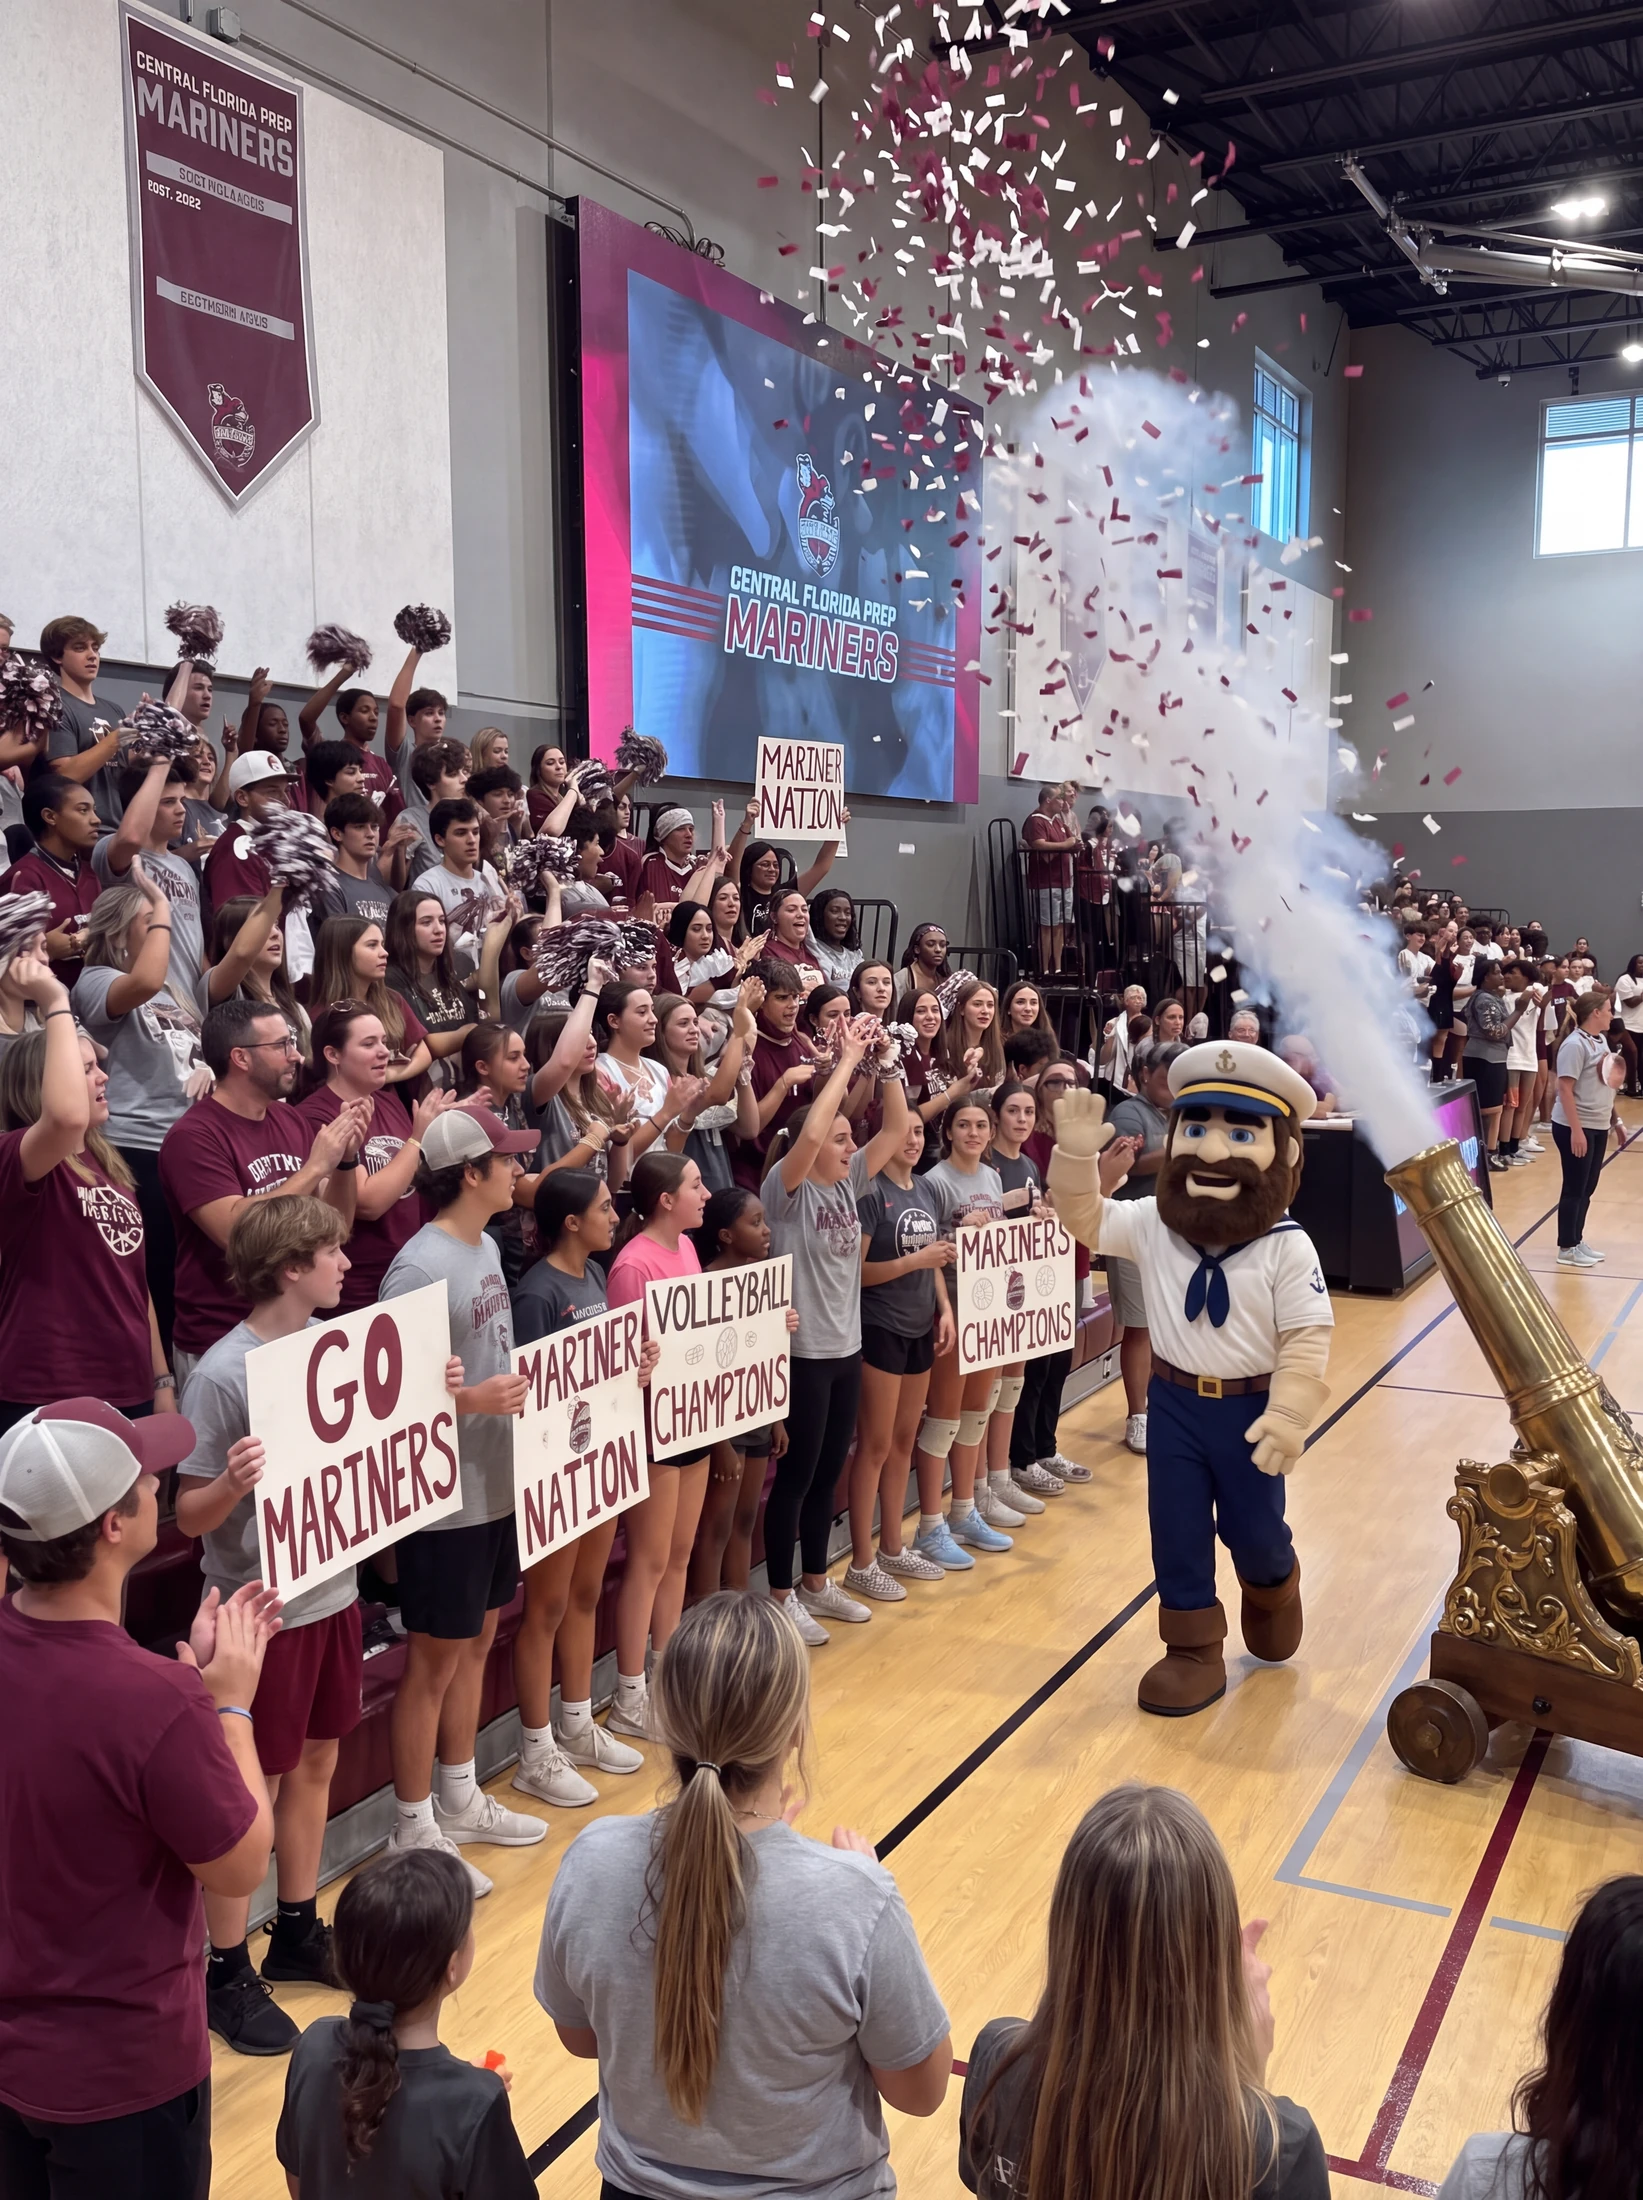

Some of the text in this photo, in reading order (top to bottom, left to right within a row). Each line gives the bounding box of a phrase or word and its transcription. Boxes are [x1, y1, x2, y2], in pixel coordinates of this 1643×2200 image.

[136, 50, 292, 134] CENTRAL FLORIDA PREP
[137, 75, 294, 178] MARINERS
[724, 592, 899, 684] MARINERS
[730, 565, 897, 628] CENTRAL FLORIDA PREP
[760, 785, 842, 830] NATION
[761, 743, 842, 784] MARINER
[961, 1218, 1071, 1273] MARINERS
[651, 1264, 790, 1335] VOLLEYBALL
[961, 1301, 1072, 1364] CHAMPIONS
[306, 1312, 403, 1444] GO
[518, 1310, 640, 1420] MARINER
[653, 1353, 788, 1446] CHAMPIONS
[263, 1410, 457, 1589] MARINERS
[523, 1430, 640, 1557] NATION
